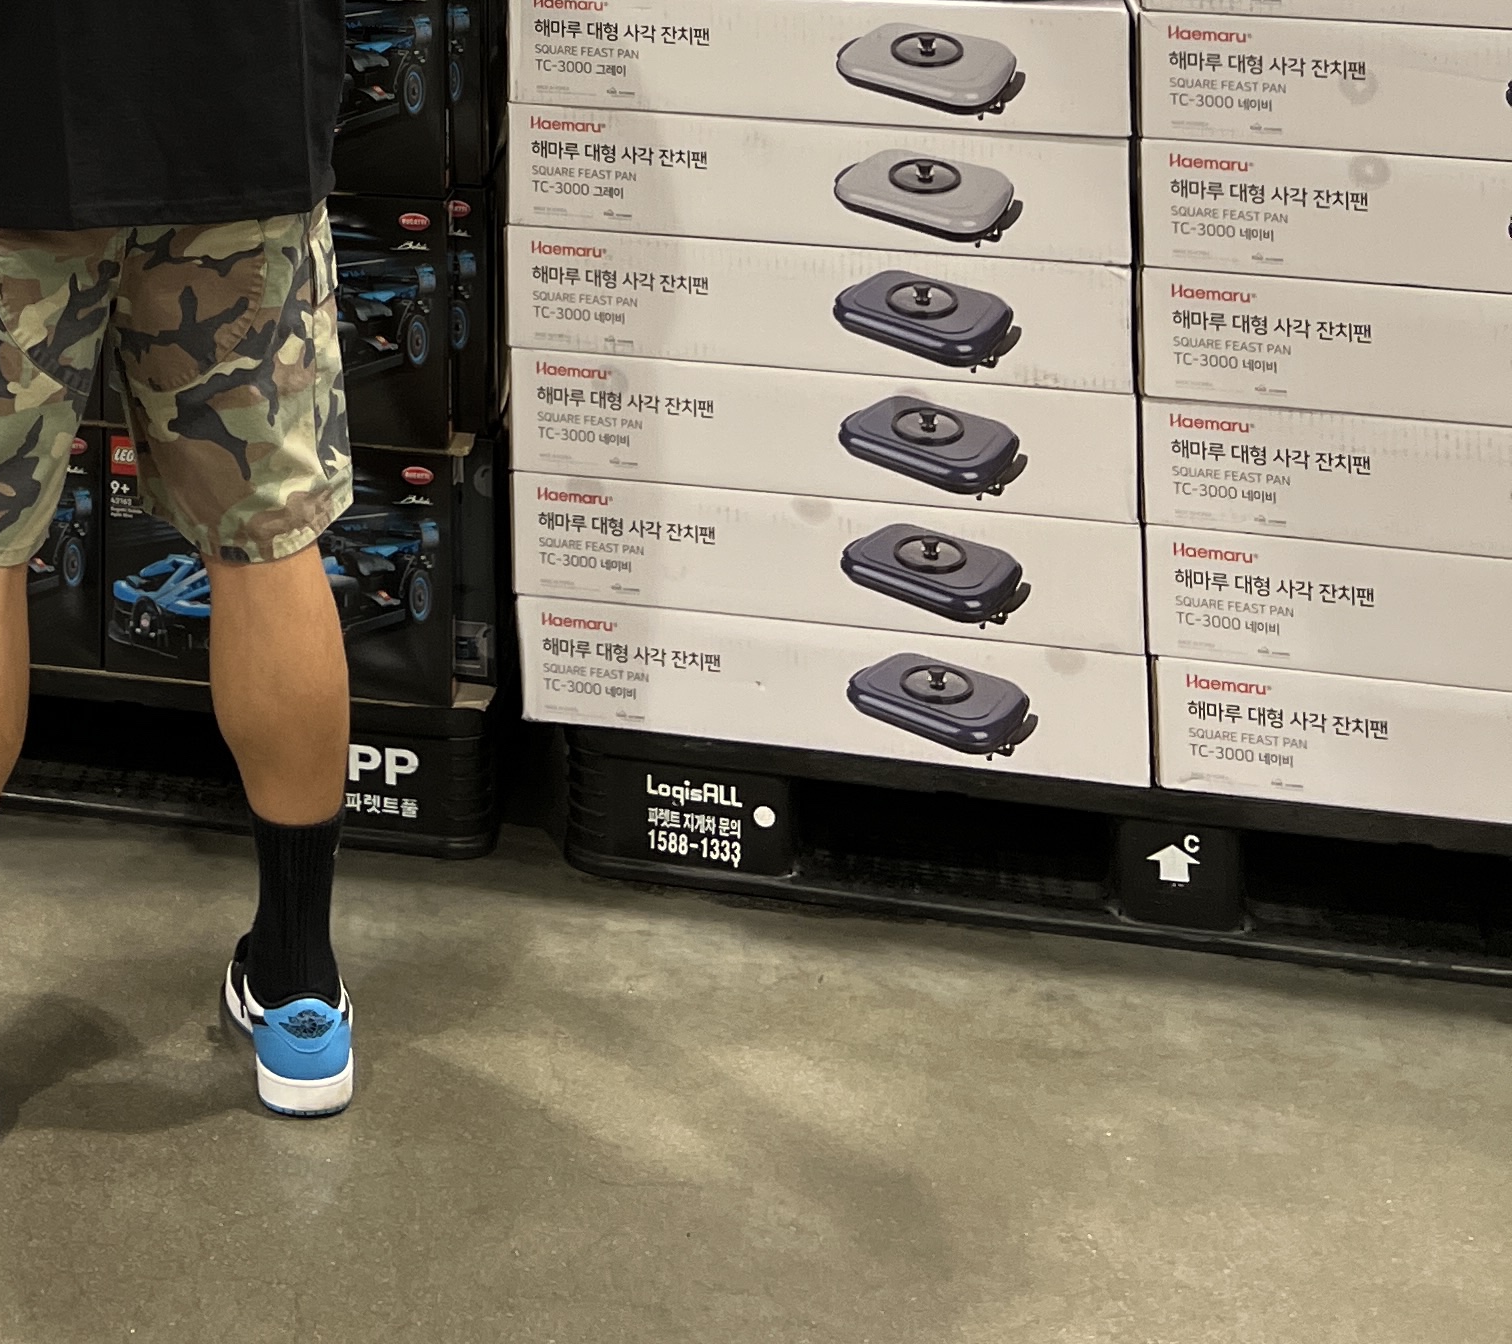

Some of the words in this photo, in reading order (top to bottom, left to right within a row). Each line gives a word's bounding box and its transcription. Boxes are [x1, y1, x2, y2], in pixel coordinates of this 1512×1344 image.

[535, 19, 582, 38] 해마루
[587, 22, 618, 41] 대형
[624, 24, 656, 43] 사각
[661, 26, 709, 46] 잔치팬
[535, 44, 577, 56] SQUARE
[581, 47, 614, 57] FEAST
[618, 48, 639, 59] PAN
[536, 59, 592, 74] TC-3000
[596, 65, 626, 77] 그레이
[1186, 674, 1266, 695] Haemaru
[1188, 700, 1242, 723] 해마루
[1248, 707, 1283, 728] 대형
[1290, 712, 1327, 733] 사각
[1332, 716, 1389, 741] 잔치팬
[1189, 728, 1237, 742] SQUARE
[1241, 732, 1278, 746] FEAST
[1283, 737, 1307, 749] PAN
[349, 744, 419, 786] PP
[1189, 743, 1254, 763] TC-3000
[1259, 753, 1293, 768] 네이비
[647, 775, 743, 808] LogisALL
[718, 816, 741, 839] 문의
[648, 830, 741, 864] 1588-1333
[1184, 835, 1200, 854] C
